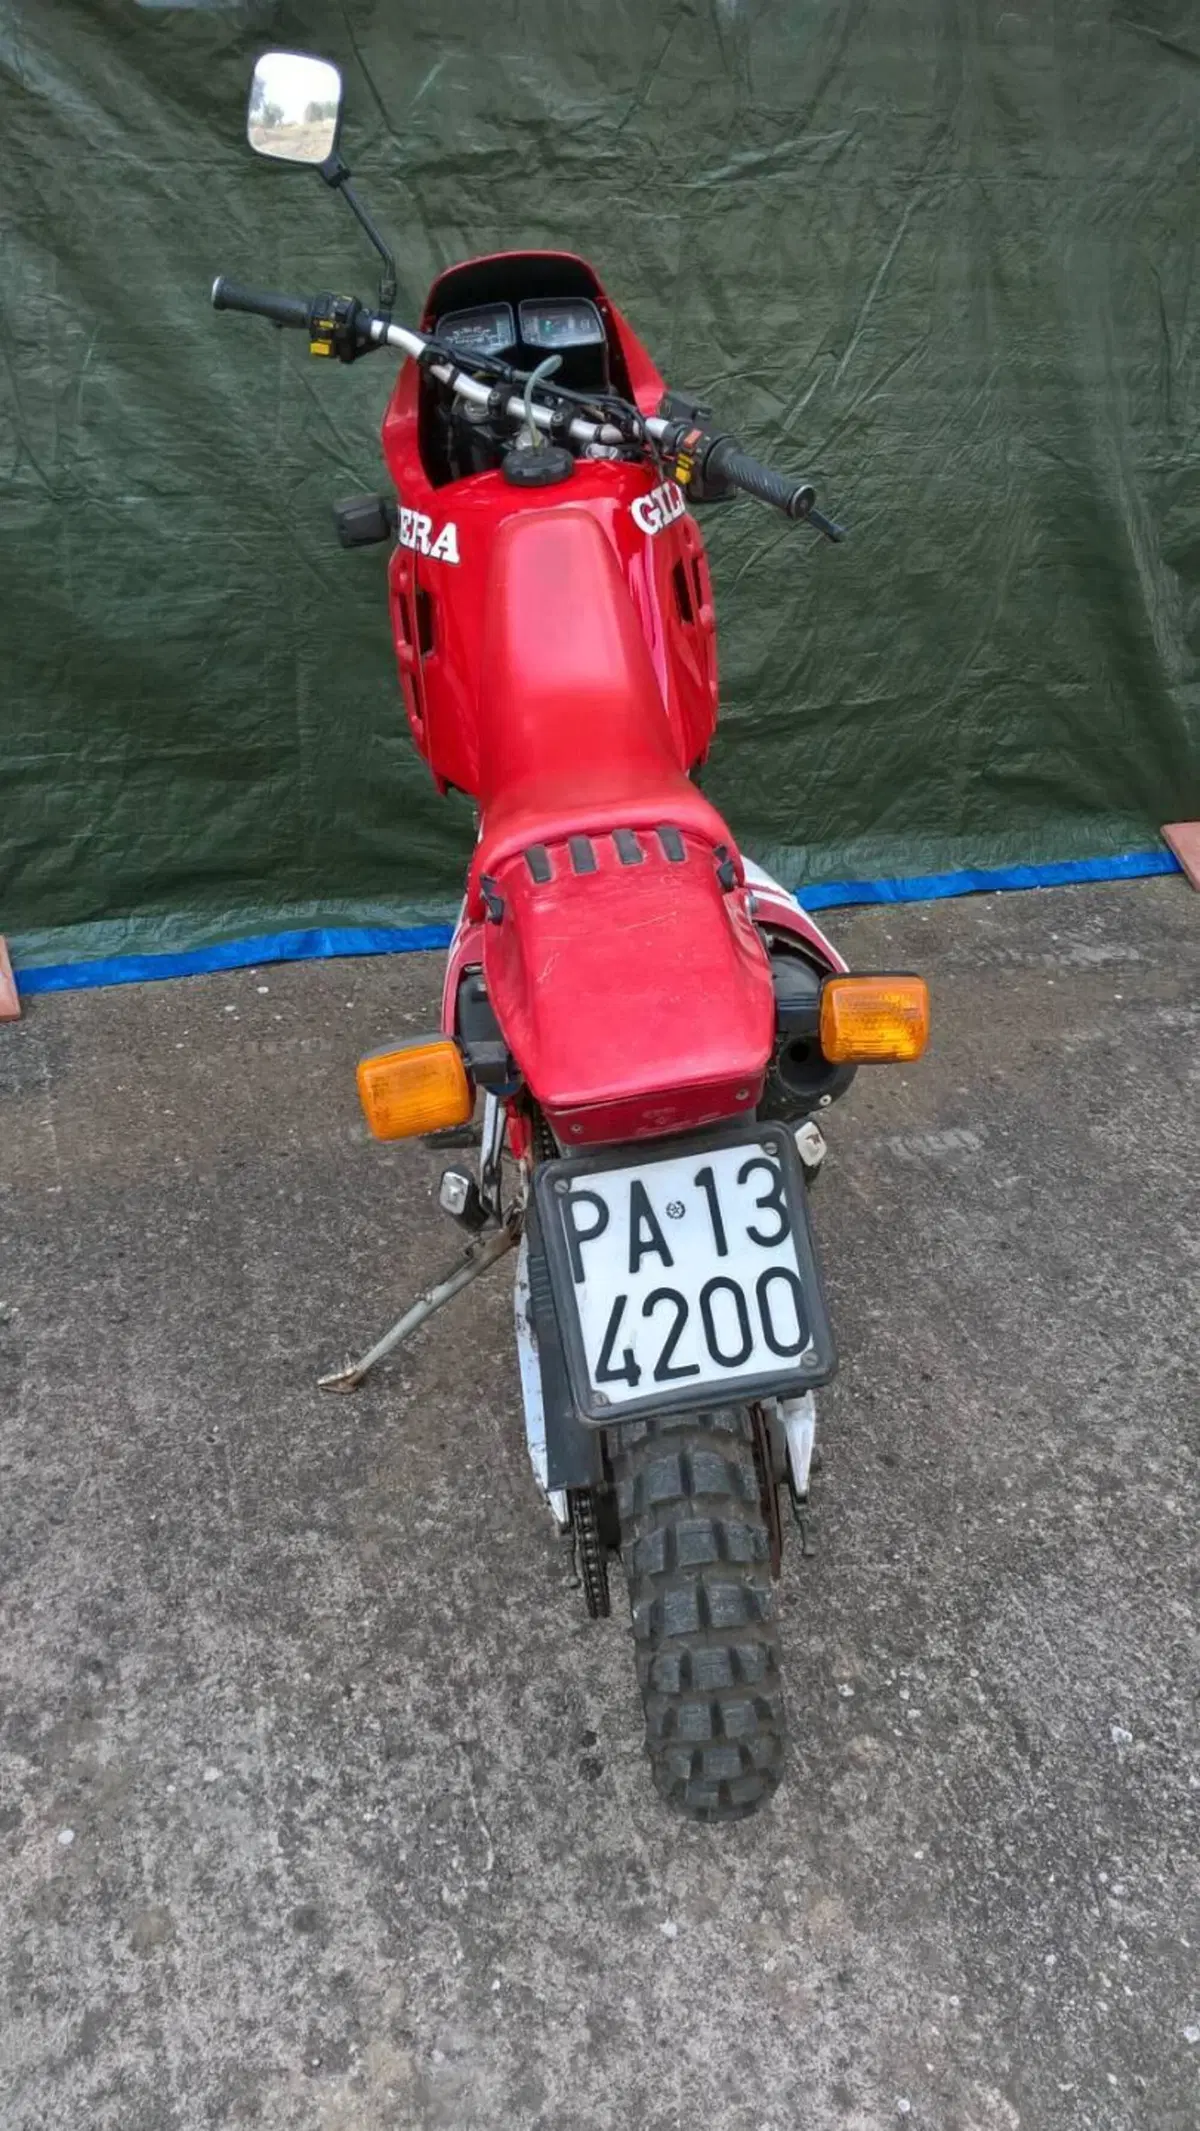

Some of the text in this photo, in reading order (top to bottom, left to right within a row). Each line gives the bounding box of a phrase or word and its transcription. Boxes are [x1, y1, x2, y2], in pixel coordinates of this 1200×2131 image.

[565, 1157, 792, 1284] PA 13
[595, 1266, 810, 1387] 4200
